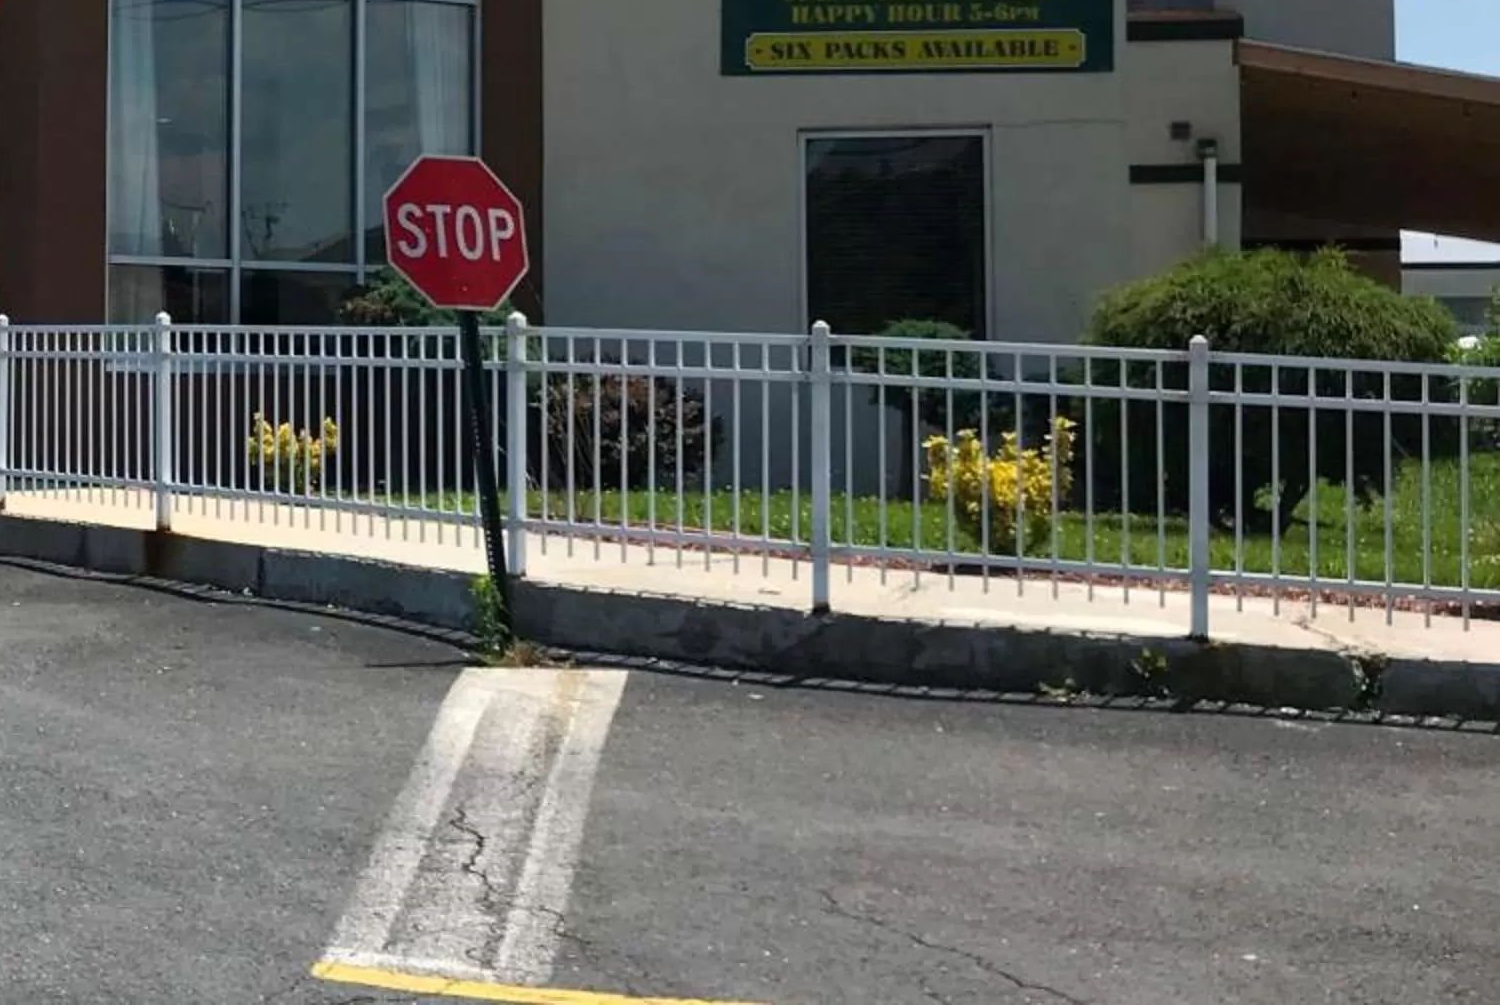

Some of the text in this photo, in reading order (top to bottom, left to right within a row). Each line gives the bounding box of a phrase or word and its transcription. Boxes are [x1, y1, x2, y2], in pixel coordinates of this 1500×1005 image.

[792, 4, 875, 24] HAPPY
[888, 4, 962, 23] HOUR
[771, 38, 1060, 60] SIX PACKS AVAILABLE
[397, 202, 515, 261] STOP
